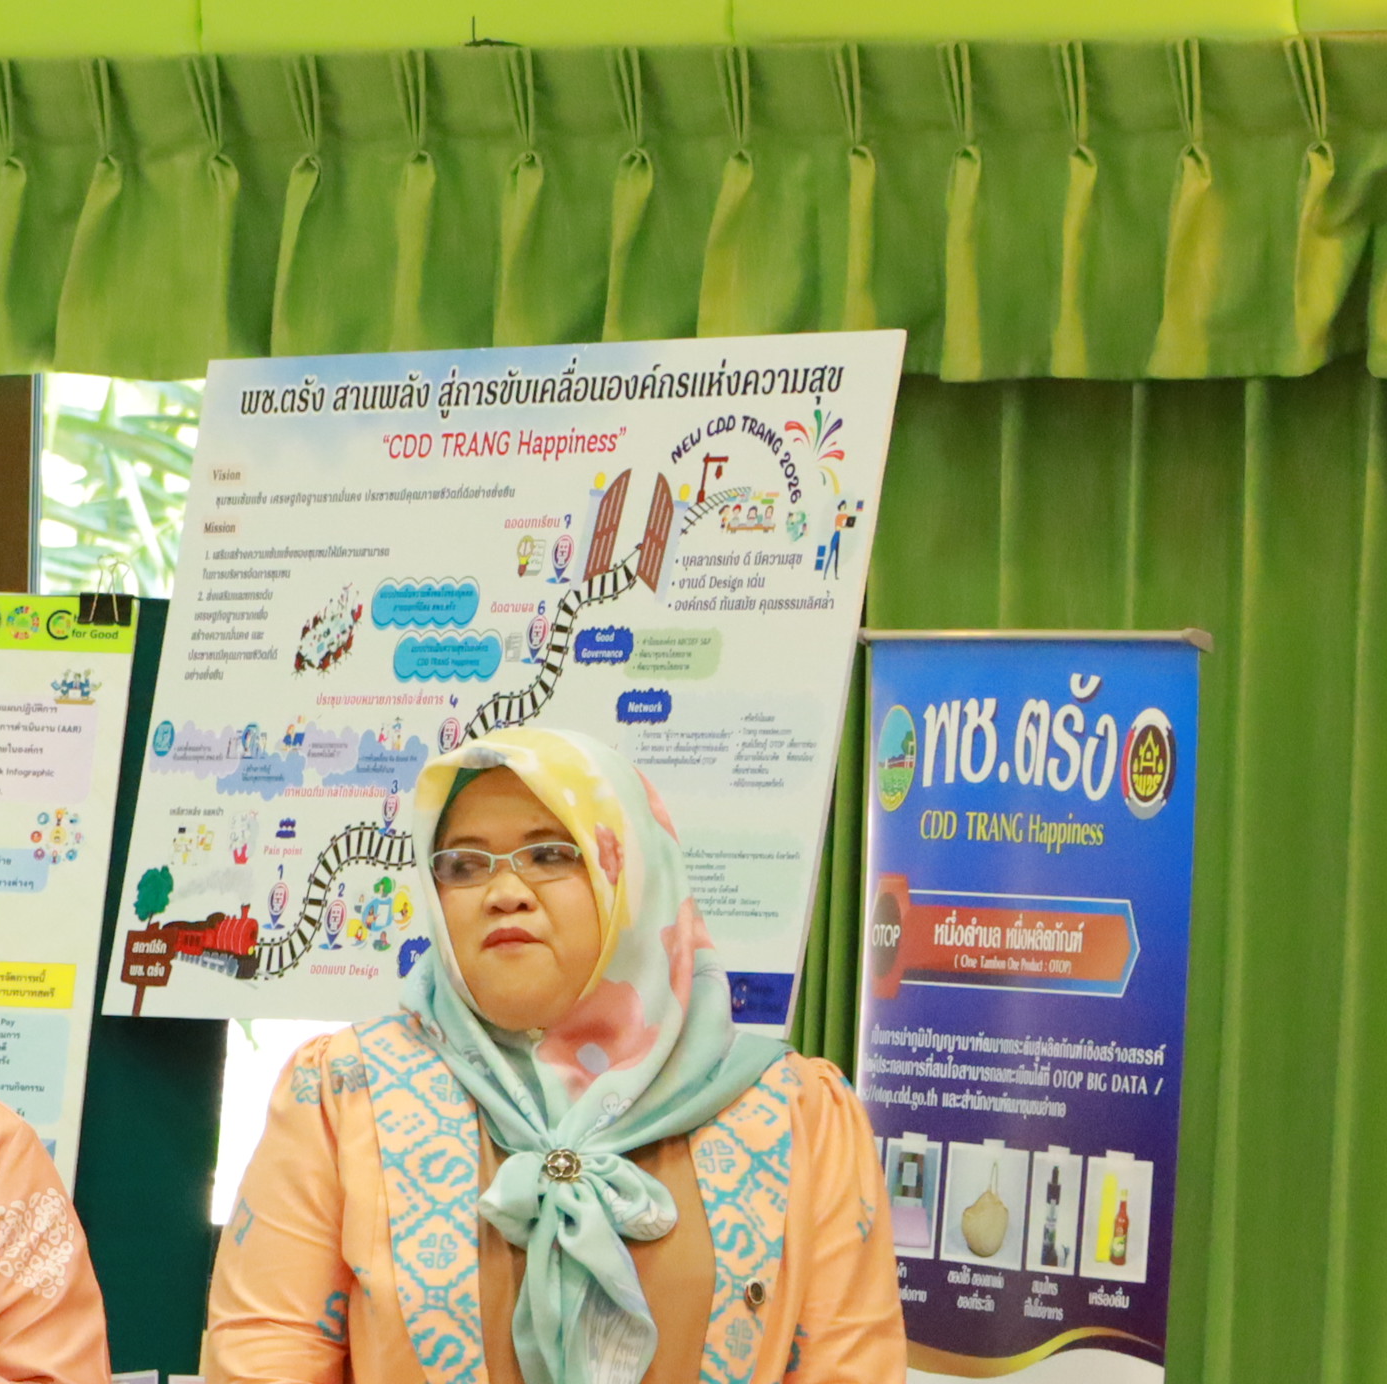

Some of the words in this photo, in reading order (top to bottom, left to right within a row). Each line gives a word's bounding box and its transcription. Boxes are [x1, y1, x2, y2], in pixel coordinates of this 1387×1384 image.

[441, 431, 510, 458] TRANG
[671, 428, 701, 464] NEW
[707, 415, 736, 437] CDD
[742, 416, 783, 456] TRANG
[779, 452, 802, 504] 2026
[212, 469, 241, 481] Vision
[203, 522, 236, 535] Mission
[71, 629, 87, 638] for
[90, 629, 118, 640] Good
[595, 632, 615, 642] Good
[627, 701, 662, 713] Network
[922, 673, 1118, 801] พช.ตรัง
[391, 779, 399, 794] 3
[921, 810, 957, 840] CDD
[966, 812, 1024, 843] TRANG
[1028, 813, 1105, 854] Happiness
[264, 846, 279, 855] Pain
[282, 846, 303, 857] point
[338, 882, 345, 897] 2
[872, 924, 901, 948] OTOP
[960, 955, 978, 968] One
[980, 956, 1006, 970] Tambon
[1007, 957, 1019, 970] One
[1020, 957, 1043, 972] Product
[1, 1018, 15, 1028] Pay
[1112, 1076, 1148, 1095] DATA
